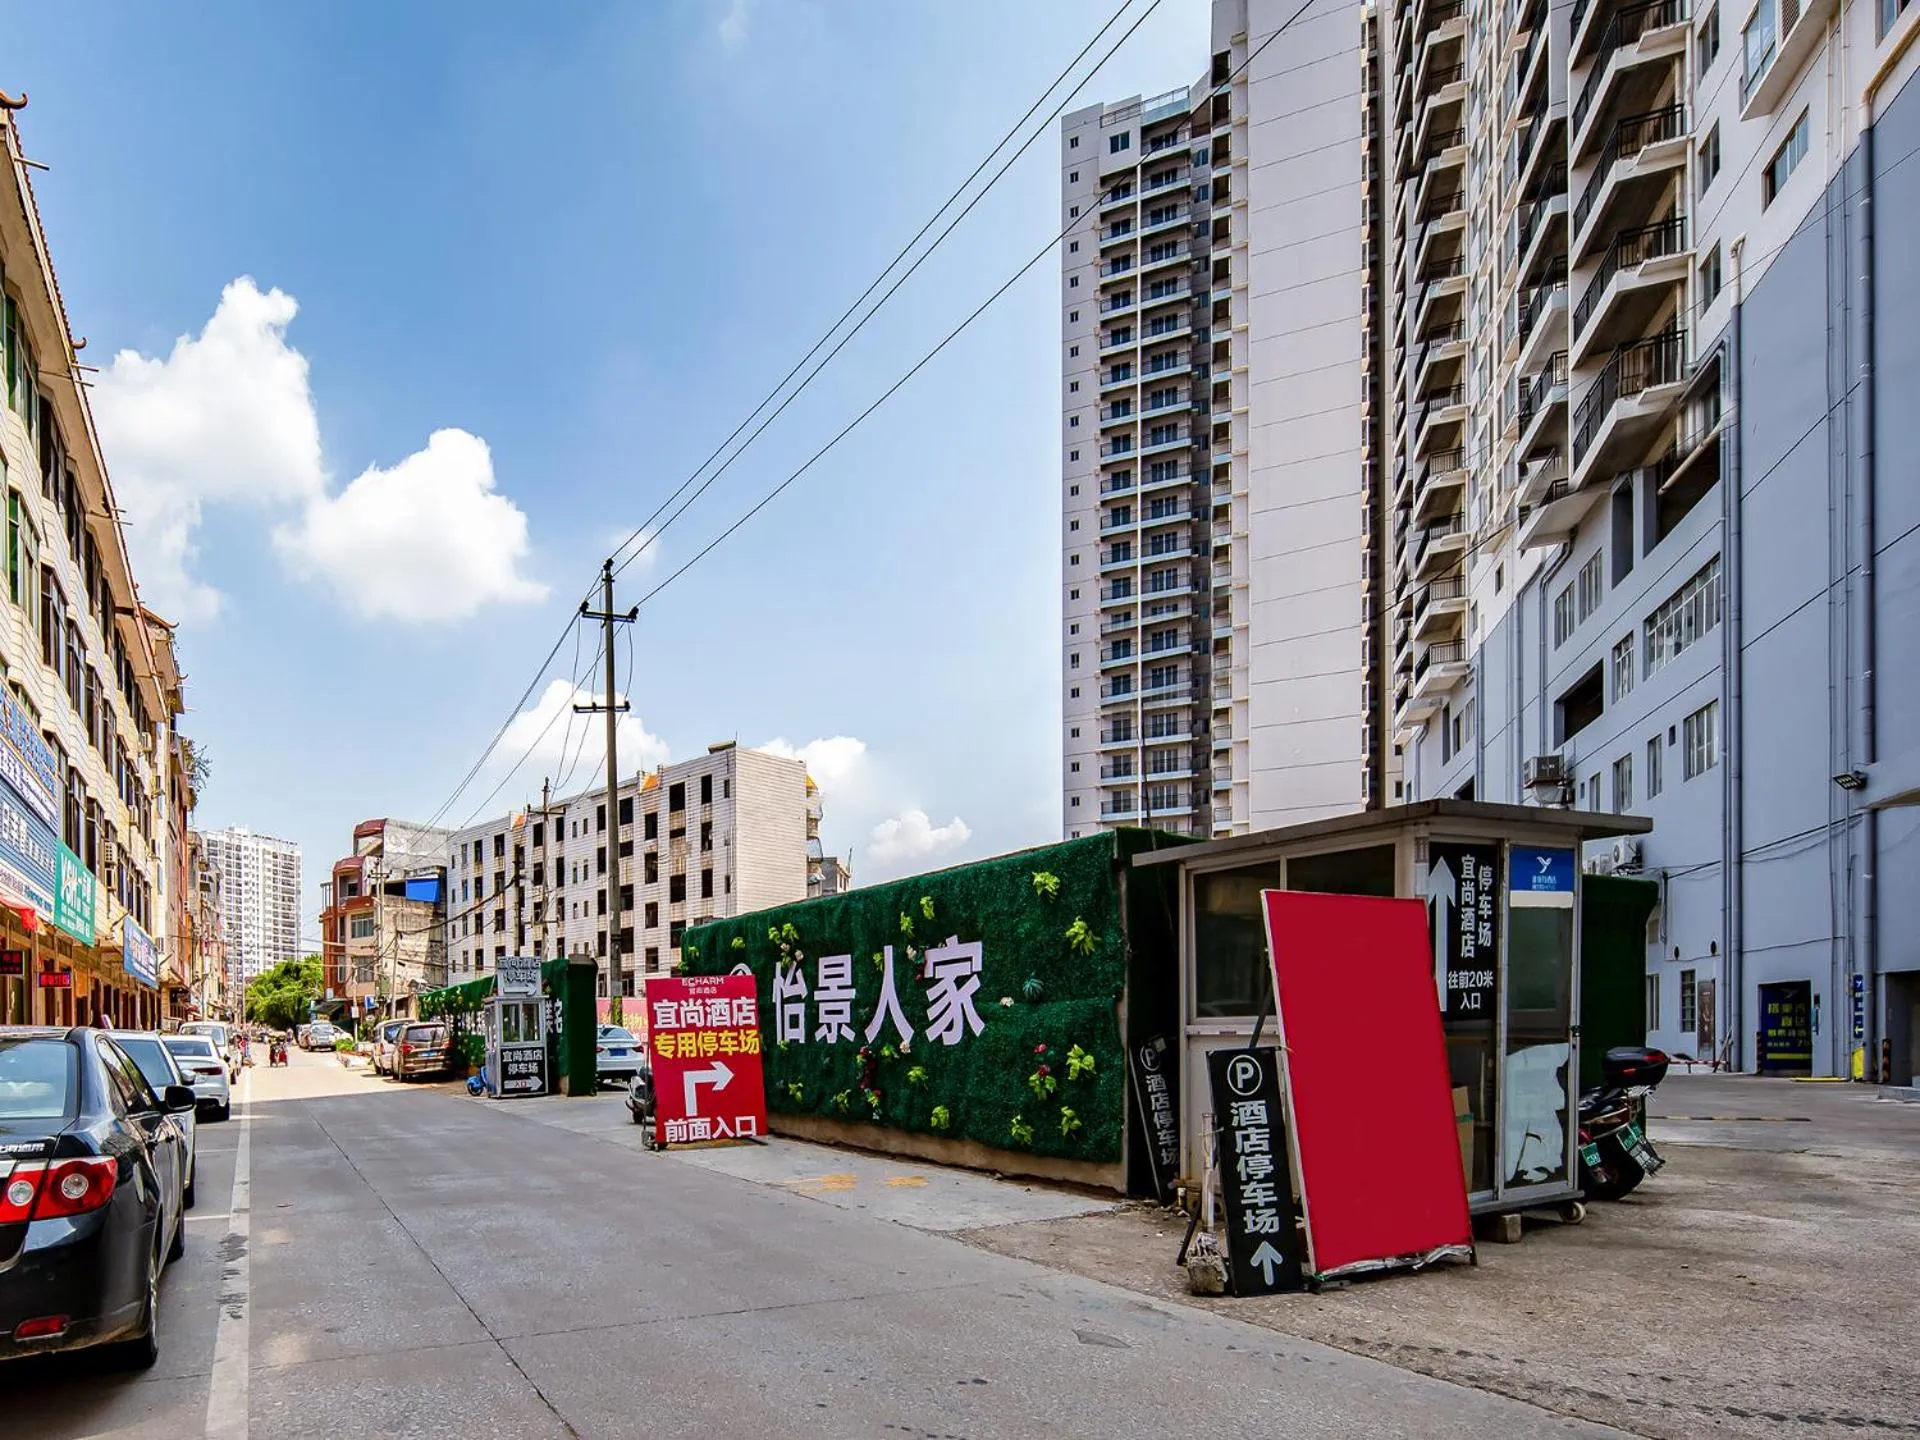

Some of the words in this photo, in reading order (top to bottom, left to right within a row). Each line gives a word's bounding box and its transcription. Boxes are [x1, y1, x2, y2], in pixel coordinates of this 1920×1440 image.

[1461, 853, 1476, 958] 宜尚酒店
[1478, 865, 1493, 947] 停车场
[681, 976, 724, 987] ECHARM
[773, 935, 985, 1045] 怡景人家
[1448, 970, 1494, 989] 往前20米
[653, 996, 756, 1029] 宜尚酒店
[1460, 992, 1481, 1010] 入口
[655, 1029, 760, 1059] 专用停车场
[508, 1061, 539, 1075] 停车场
[664, 1115, 757, 1143] 前面入口
[1146, 1075, 1179, 1166] 酒店停车场
[1229, 1100, 1280, 1234] 酒店停车场
